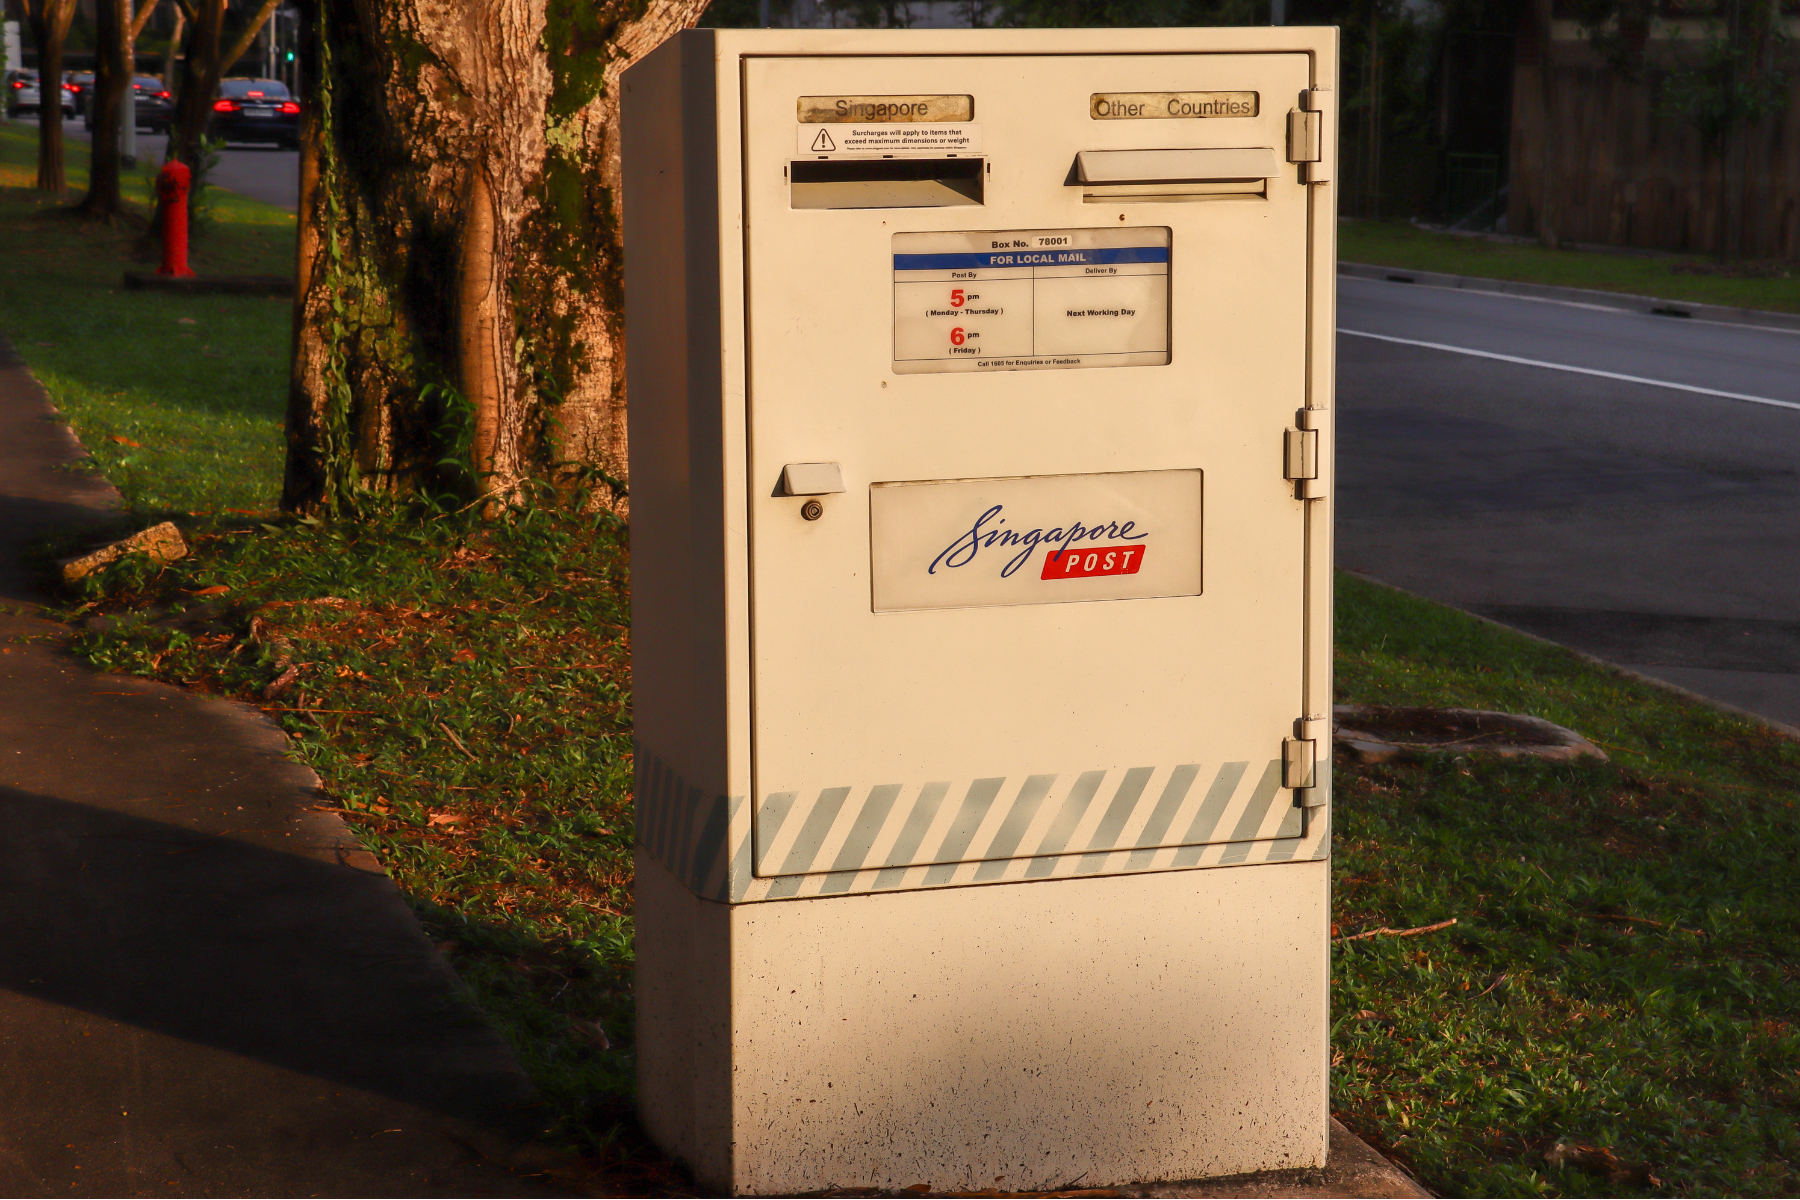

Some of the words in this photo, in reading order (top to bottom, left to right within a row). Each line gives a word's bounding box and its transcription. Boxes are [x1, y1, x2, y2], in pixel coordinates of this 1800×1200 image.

[835, 99, 928, 121] Singapore
[1096, 99, 1145, 116] Other
[1167, 98, 1250, 115] Countries
[852, 129, 888, 137] Surcharges
[902, 129, 920, 137] apply
[947, 137, 970, 145] weight
[991, 241, 1011, 249] Box
[1012, 240, 1029, 248] No.
[1038, 237, 1069, 246] 78001
[990, 256, 1014, 265] FOR
[1017, 254, 1055, 264] LOCAL
[1058, 253, 1087, 263] MAIL
[968, 272, 977, 280] By
[1109, 267, 1118, 275] By
[950, 289, 965, 308] 5
[1087, 309, 1119, 317] Working
[1121, 308, 1136, 317] Day
[950, 327, 965, 346] 6
[1015, 359, 1044, 367] Enquiries
[928, 504, 1149, 579] Singapore
[1064, 550, 1135, 573] POST
